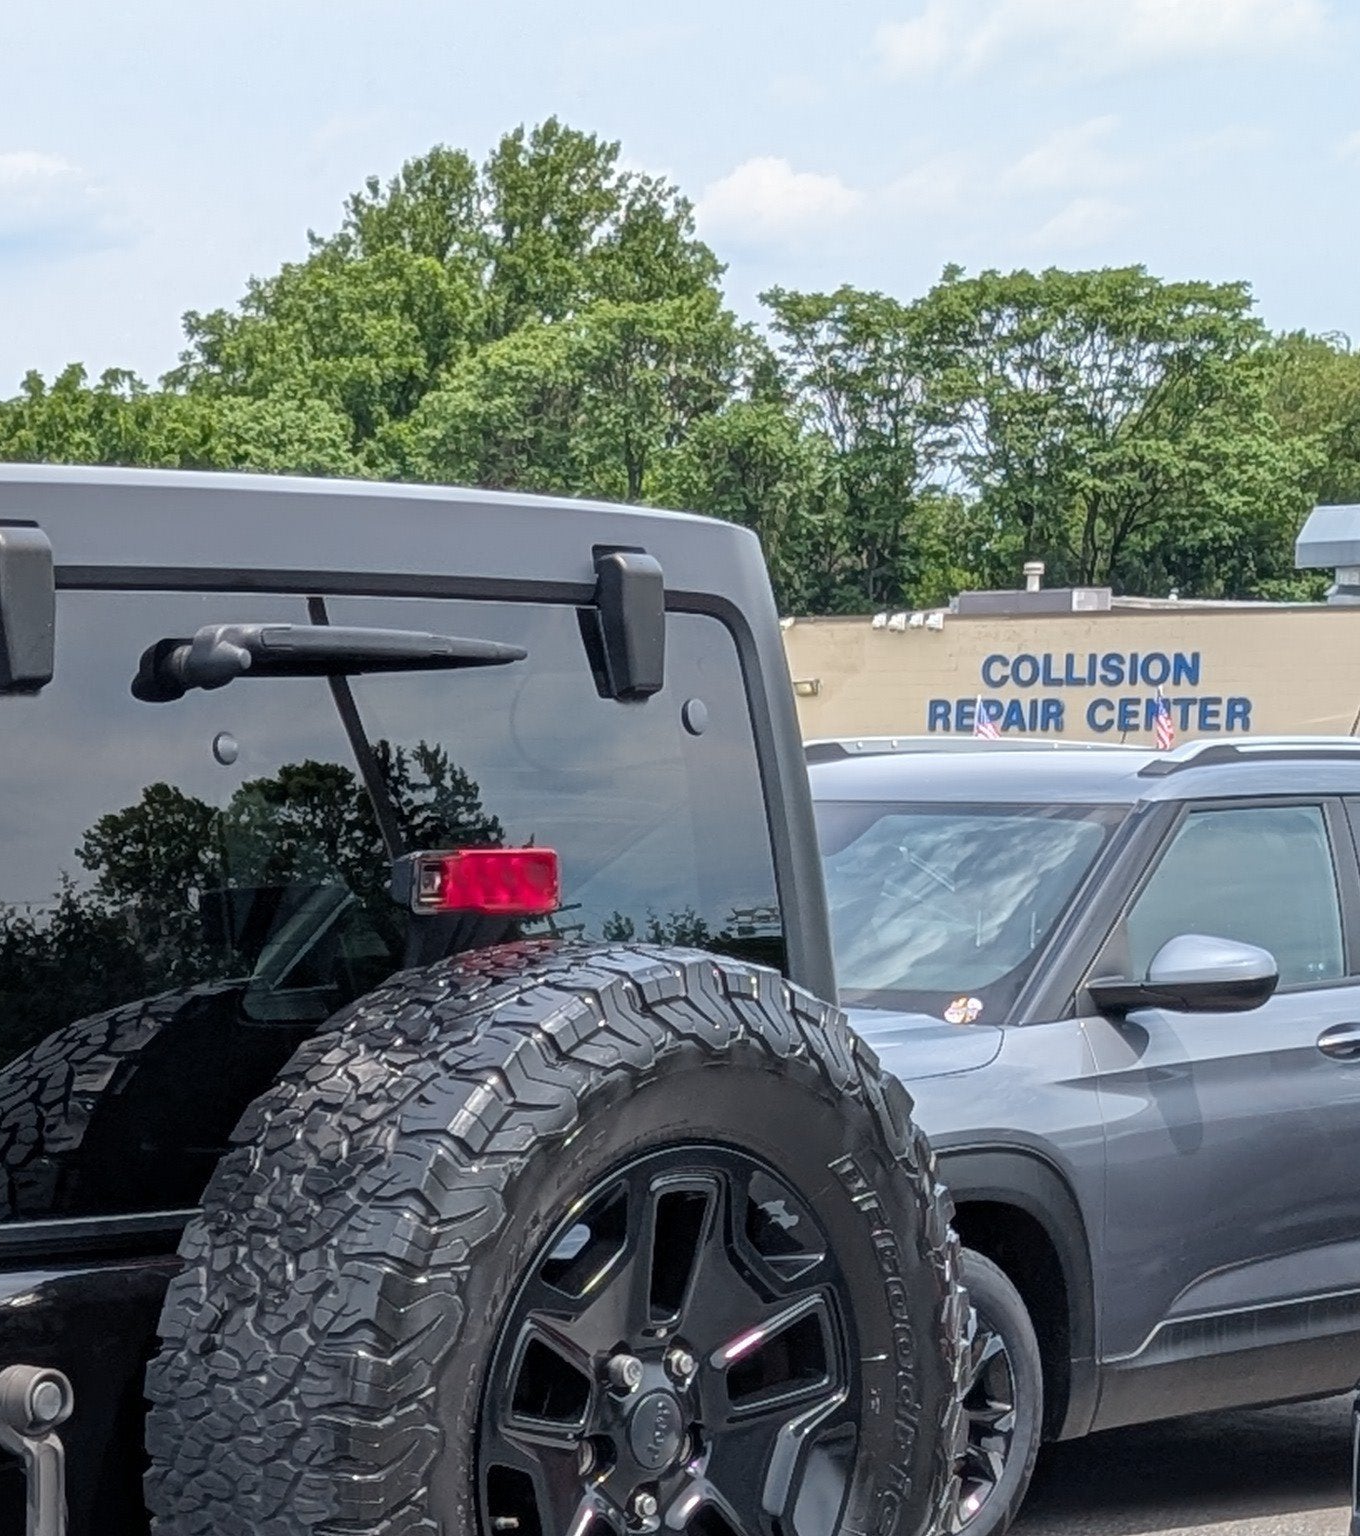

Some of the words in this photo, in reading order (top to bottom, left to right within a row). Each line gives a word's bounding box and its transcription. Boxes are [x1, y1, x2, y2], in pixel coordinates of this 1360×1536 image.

[982, 652, 1201, 688] COLLISION
[927, 698, 1065, 732] REPAIR
[1086, 696, 1252, 733] CENTER
